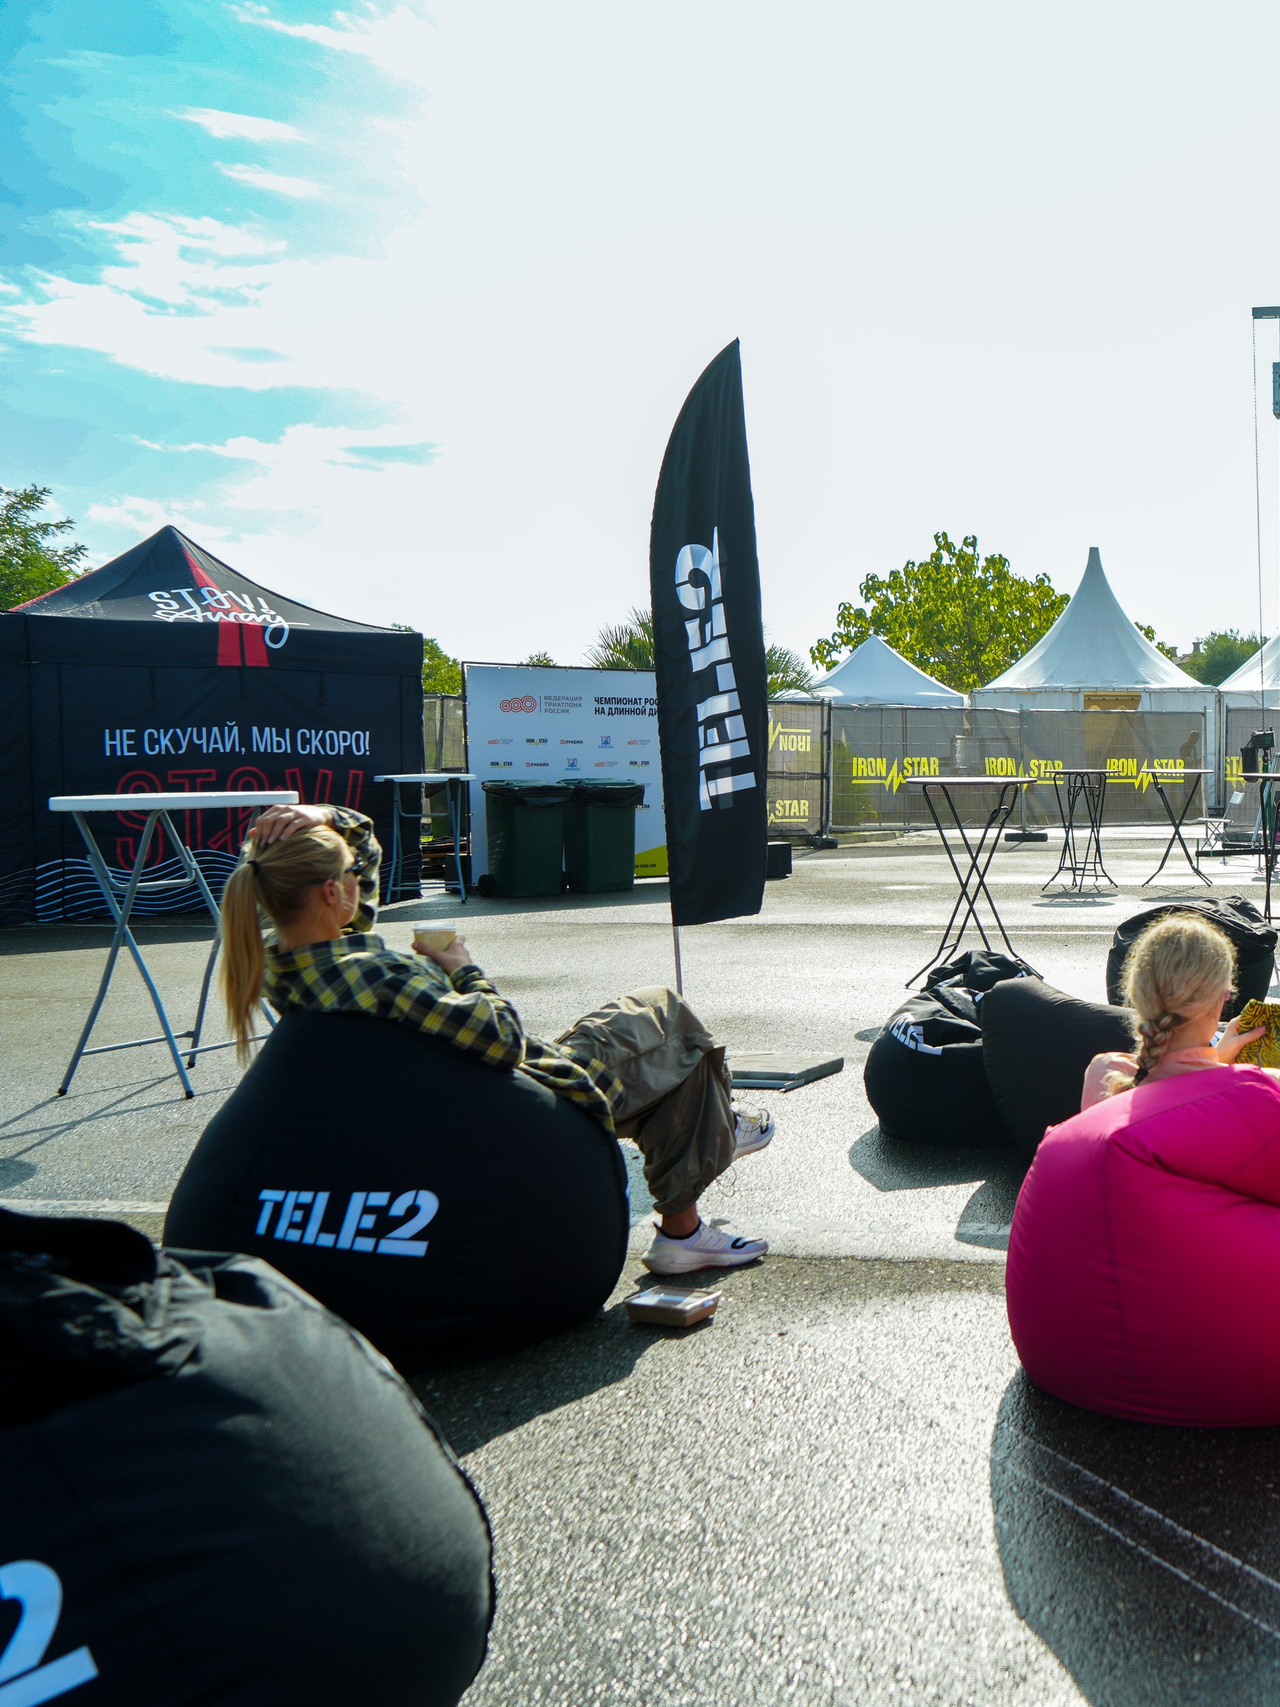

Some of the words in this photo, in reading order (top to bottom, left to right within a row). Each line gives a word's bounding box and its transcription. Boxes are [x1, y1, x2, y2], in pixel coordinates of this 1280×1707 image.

[675, 526, 757, 810] TELE2
[594, 696, 642, 706] ЧЕМПИОНАТ
[644, 697, 659, 706] РОС
[594, 706, 606, 716] НА
[607, 705, 647, 717] ДЛИННОЙ
[104, 728, 137, 756] НЕ
[143, 720, 246, 756] СКУЧАЙ,
[251, 725, 292, 754] МЫ
[296, 728, 371, 756] СКОРО!
[852, 757, 887, 777] IRON
[903, 756, 940, 776] STAR
[985, 757, 1017, 776] IRON
[1029, 759, 1064, 778] STAR
[1106, 758, 1137, 777] IRON
[1153, 758, 1185, 776] STAR
[775, 799, 809, 816] STAR
[255, 1189, 440, 1257] TELE2
